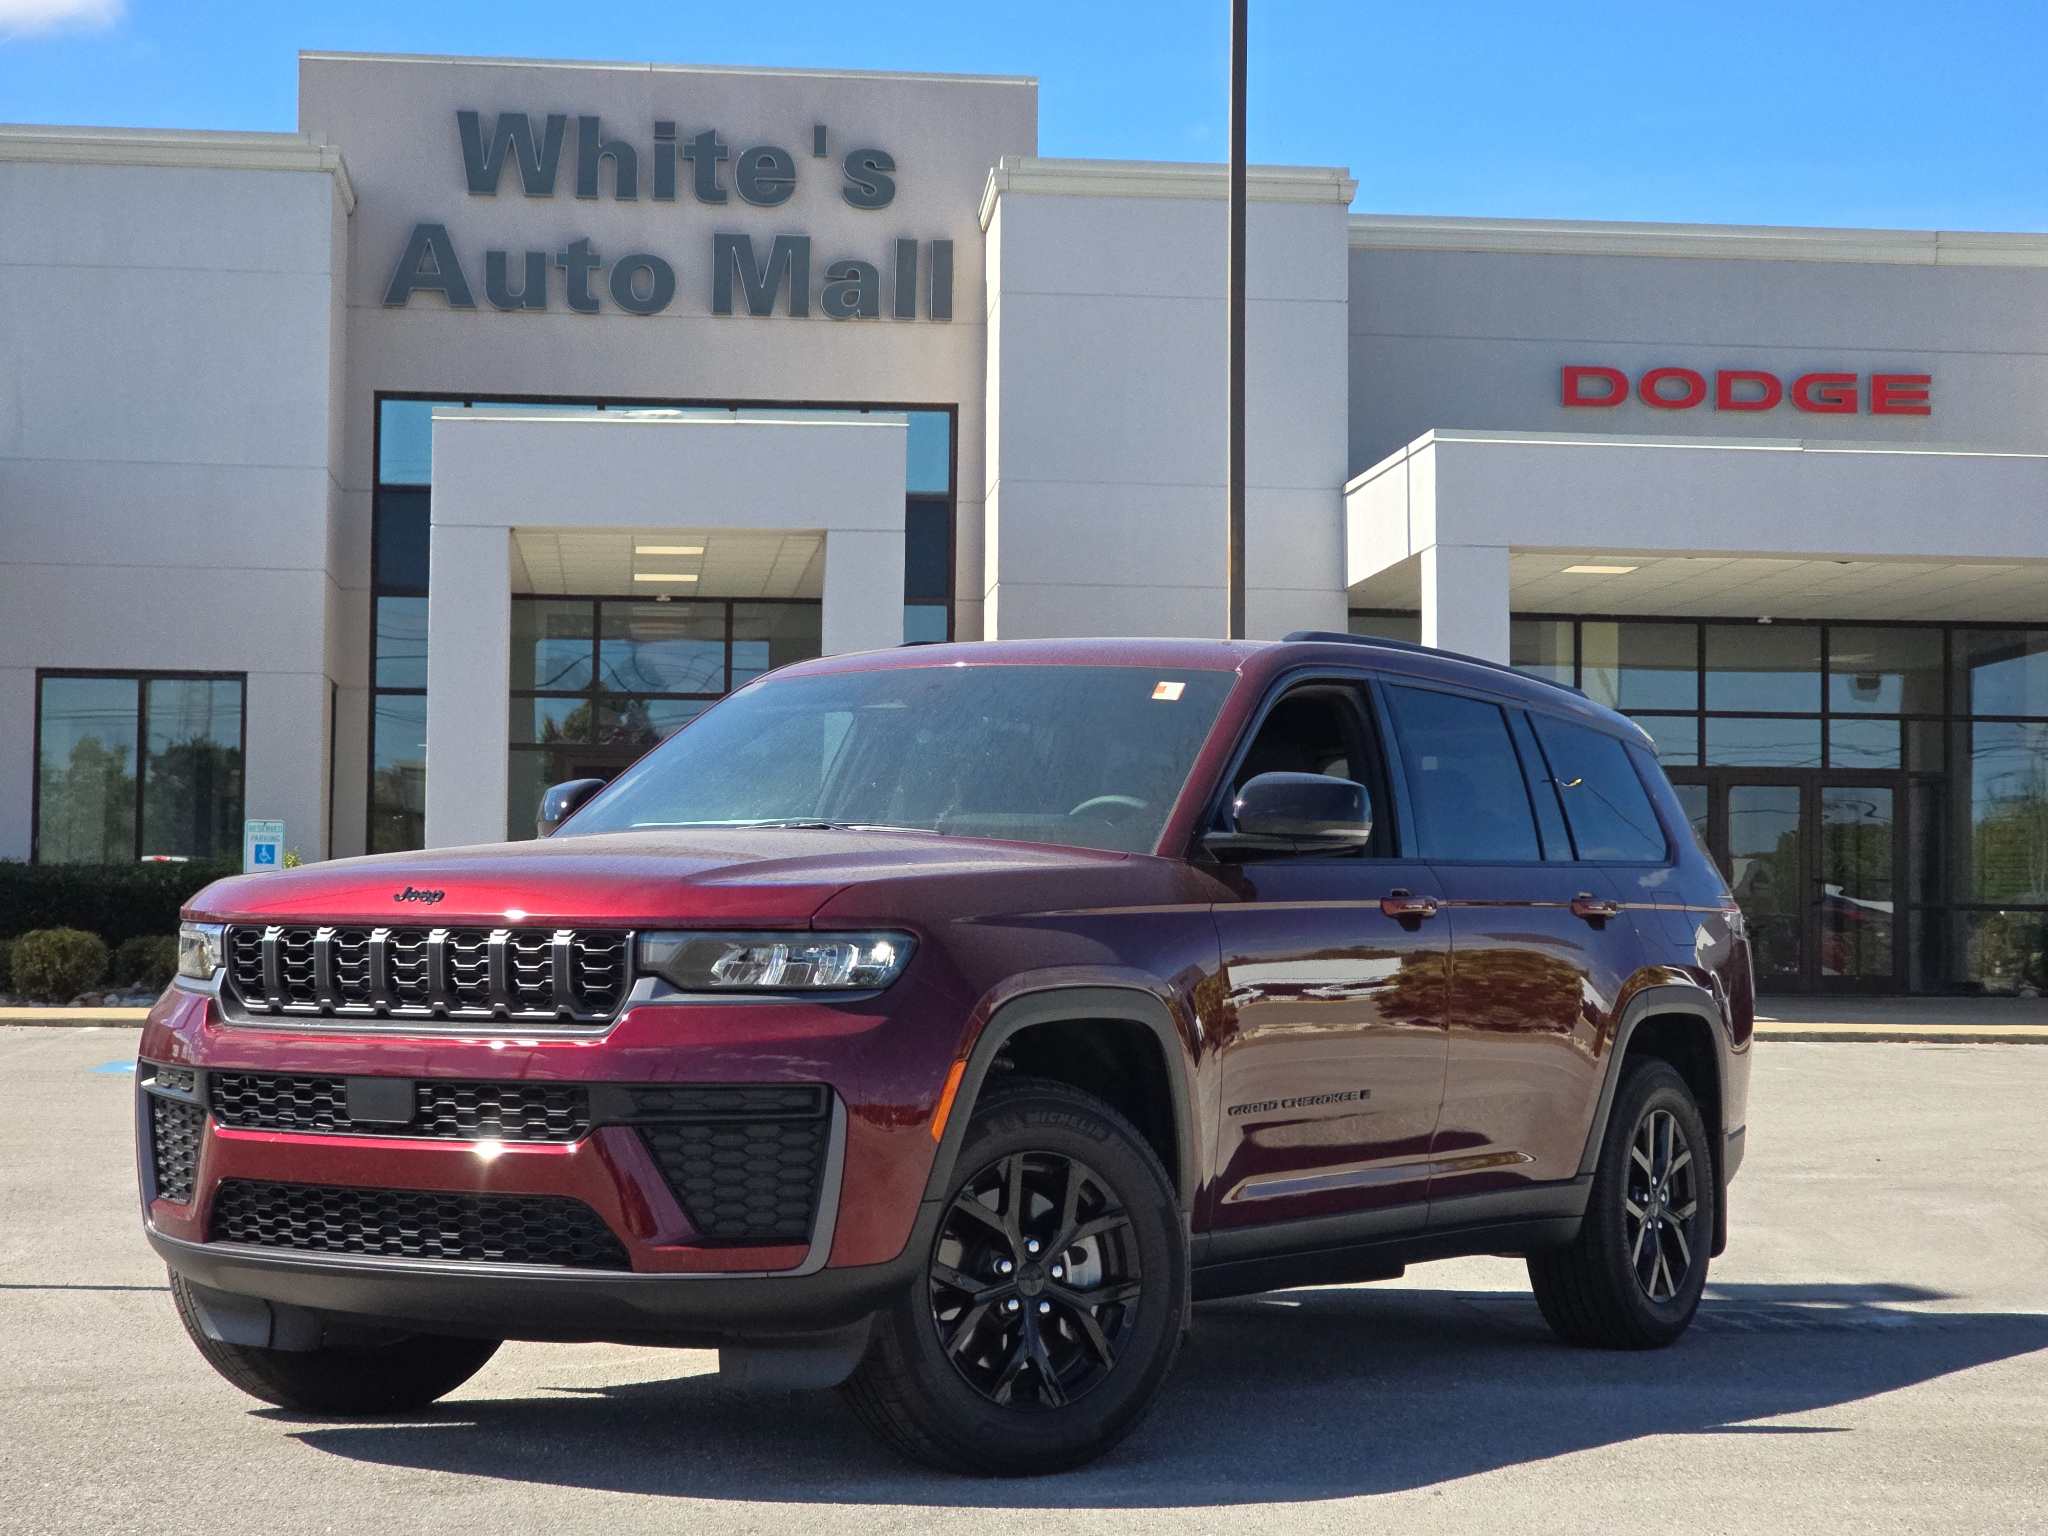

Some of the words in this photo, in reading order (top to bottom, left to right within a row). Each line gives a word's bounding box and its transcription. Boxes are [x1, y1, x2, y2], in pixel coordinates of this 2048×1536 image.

[456, 110, 897, 210] White's
[382, 223, 677, 315] Auto
[711, 232, 954, 321] Mall
[1562, 365, 1932, 415] DODGE
[247, 824, 283, 833] RESERVED
[250, 834, 281, 843] PARKING
[393, 886, 445, 905] Jeep
[1228, 1100, 1278, 1116] GRAND
[1281, 1091, 1358, 1109] CHEROKEE
[1025, 1111, 1108, 1140] MICHELIN
